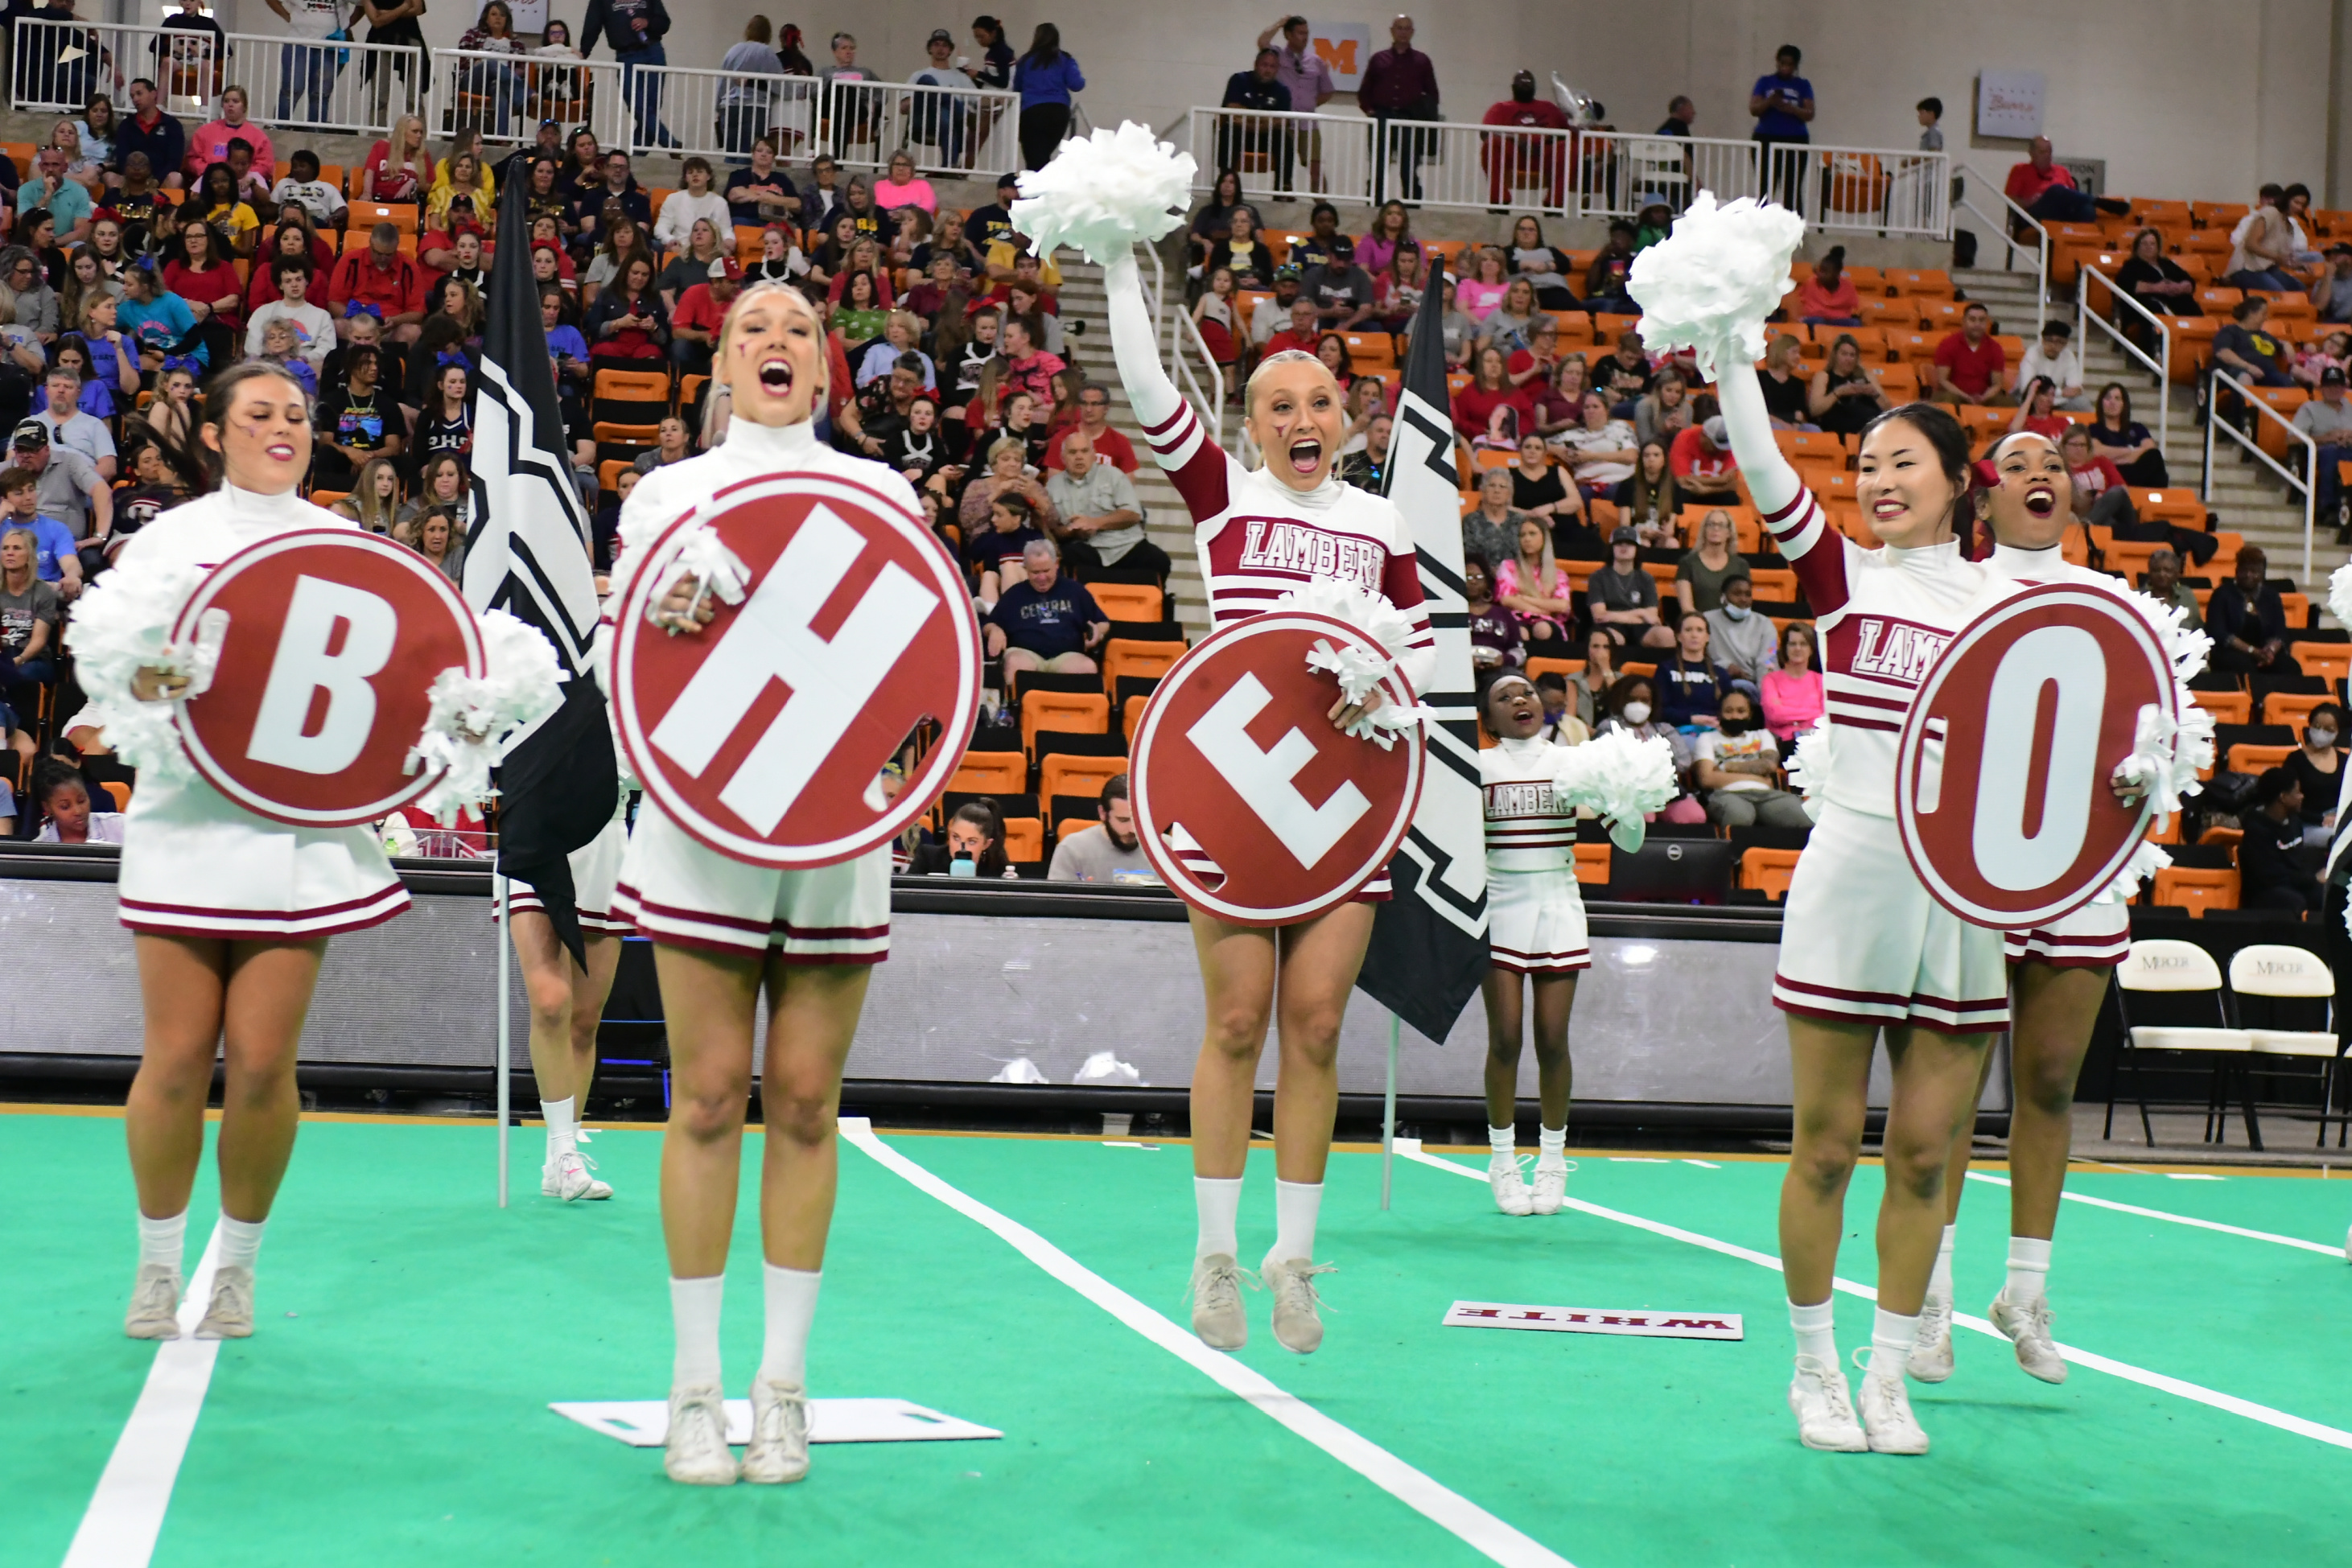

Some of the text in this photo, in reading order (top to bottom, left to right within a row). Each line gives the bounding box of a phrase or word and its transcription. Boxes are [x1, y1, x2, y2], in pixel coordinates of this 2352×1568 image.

[1313, 38, 1357, 74] M
[1239, 521, 1386, 593] LAMBERT
[1020, 601, 1072, 619] CENTRAL
[246, 574, 397, 774] B
[649, 502, 939, 838] H
[1851, 618, 1952, 683] LAM
[1186, 670, 1372, 870] E
[2142, 956, 2189, 971] MERCER
[2257, 961, 2305, 976] MERCER
[1457, 1308, 1734, 1329] WHITE
